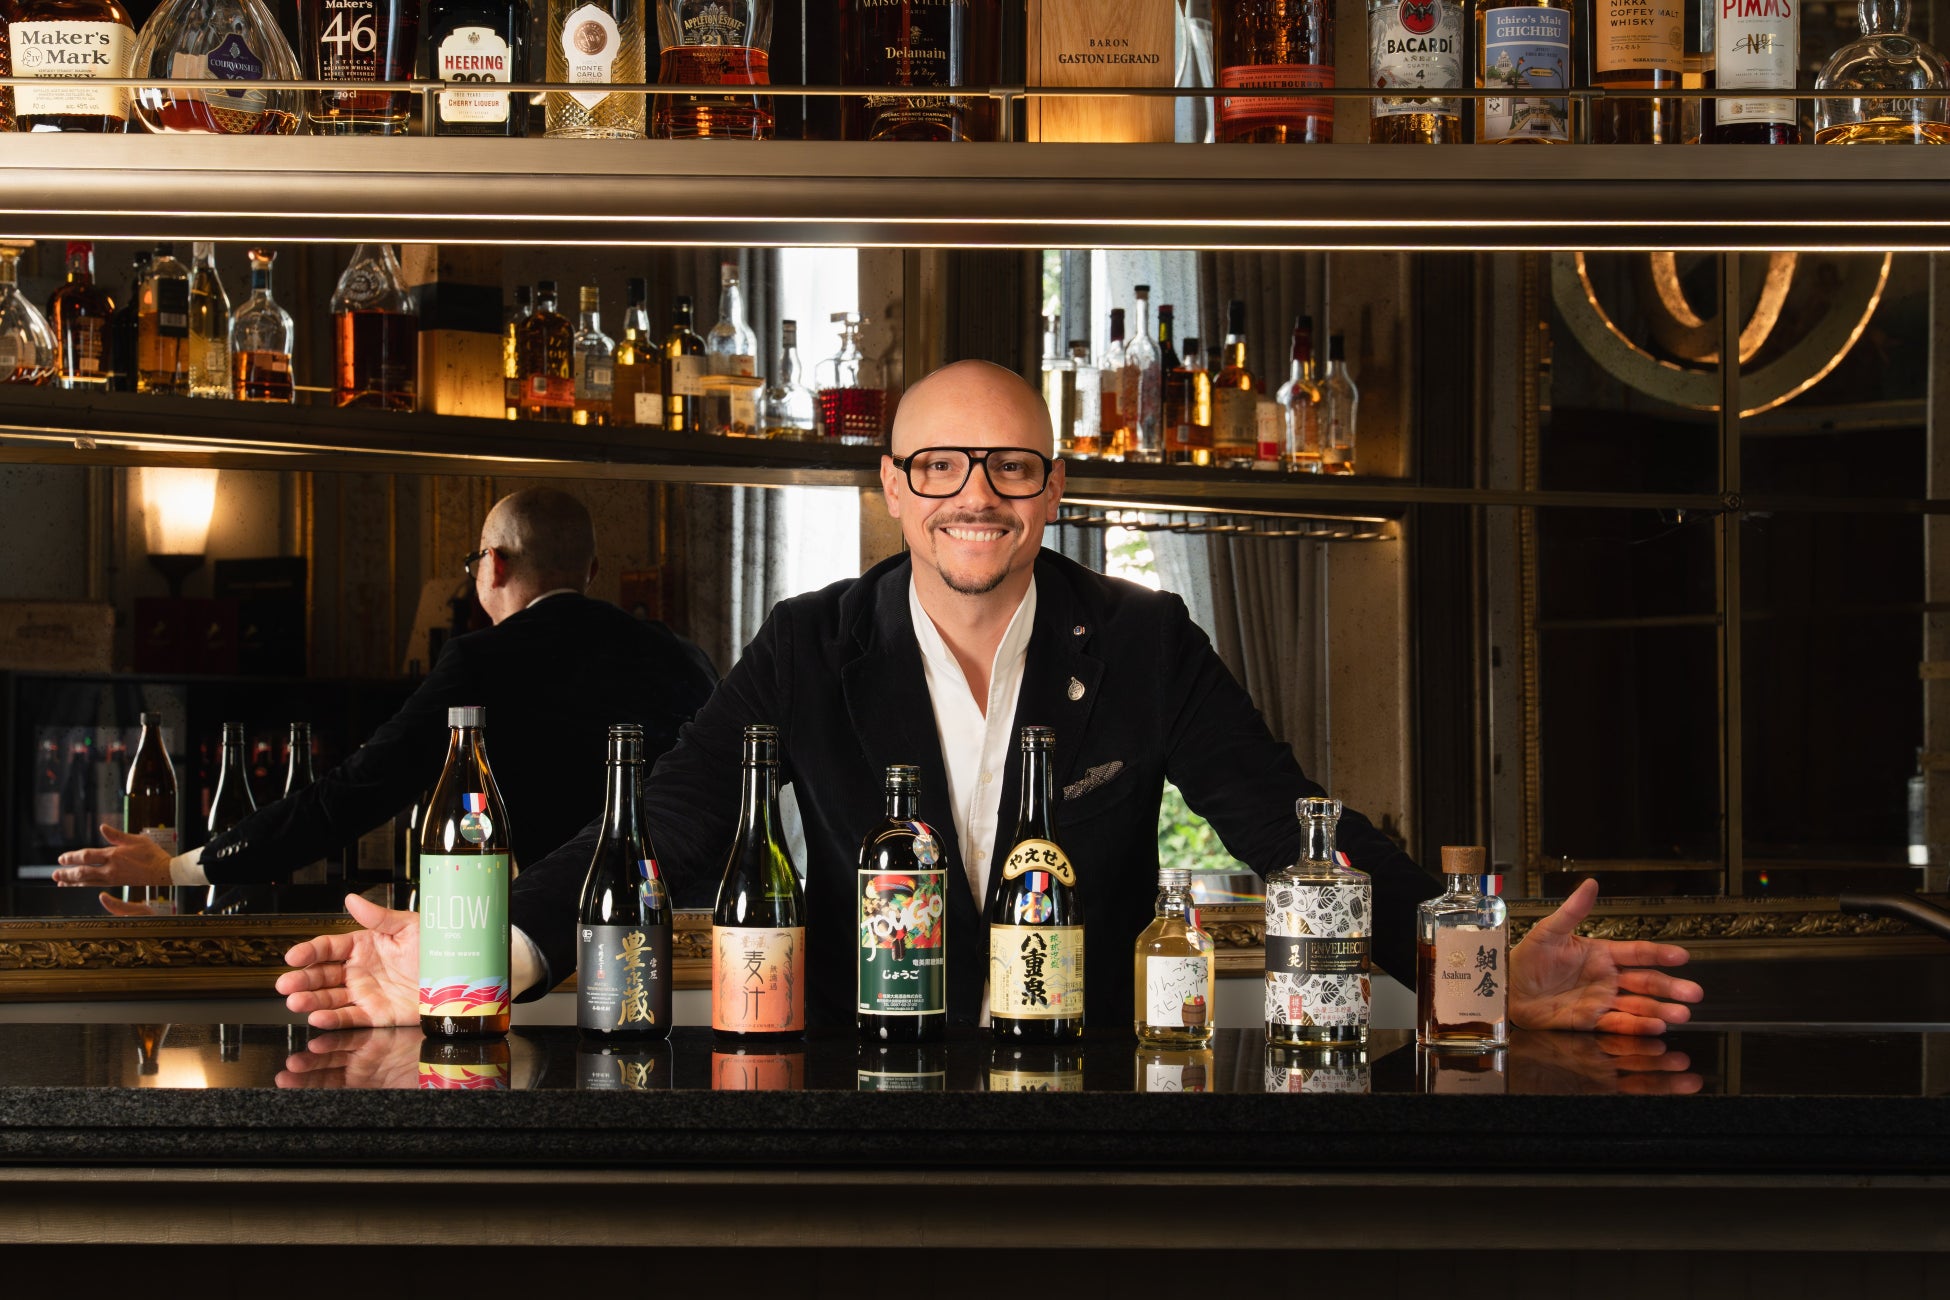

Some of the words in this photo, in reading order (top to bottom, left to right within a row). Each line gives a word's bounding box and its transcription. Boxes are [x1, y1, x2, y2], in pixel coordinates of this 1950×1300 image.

[325, 0, 373, 9] Maker's
[1610, 8, 1655, 17] COFFEY
[1658, 8, 1680, 18] MALT
[684, 15, 718, 30] APPLETON
[719, 15, 744, 30] ESTATE
[1497, 15, 1536, 25] Ichiro's
[1540, 15, 1562, 26] Malt
[1610, 18, 1655, 27] WHISKY
[21, 30, 110, 45] Maker's
[321, 12, 377, 56] 46
[1496, 26, 1562, 38] CHICHIBU
[1089, 38, 1129, 48] BARON
[1387, 35, 1453, 54] BACARDÍ
[46, 49, 109, 65] Mark
[885, 46, 947, 60] Delamain
[1058, 53, 1104, 65] GASTON
[1106, 53, 1160, 65] LEGRAND
[210, 59, 261, 73] COURVOISIER
[445, 55, 503, 70] HEERING
[1415, 69, 1425, 80] 4
[448, 99, 472, 107] CHERRY
[474, 99, 500, 107] LIQUEUR
[906, 97, 926, 109] XO
[1009, 847, 1071, 878] やえせん
[425, 895, 490, 930] GLOW
[882, 969, 920, 980] じょうご
[1020, 932, 1048, 1006] 八重泉
[1441, 970, 1472, 980] Asakura
[1473, 944, 1499, 998] 朝倉
[742, 950, 767, 1021] 麦汁
